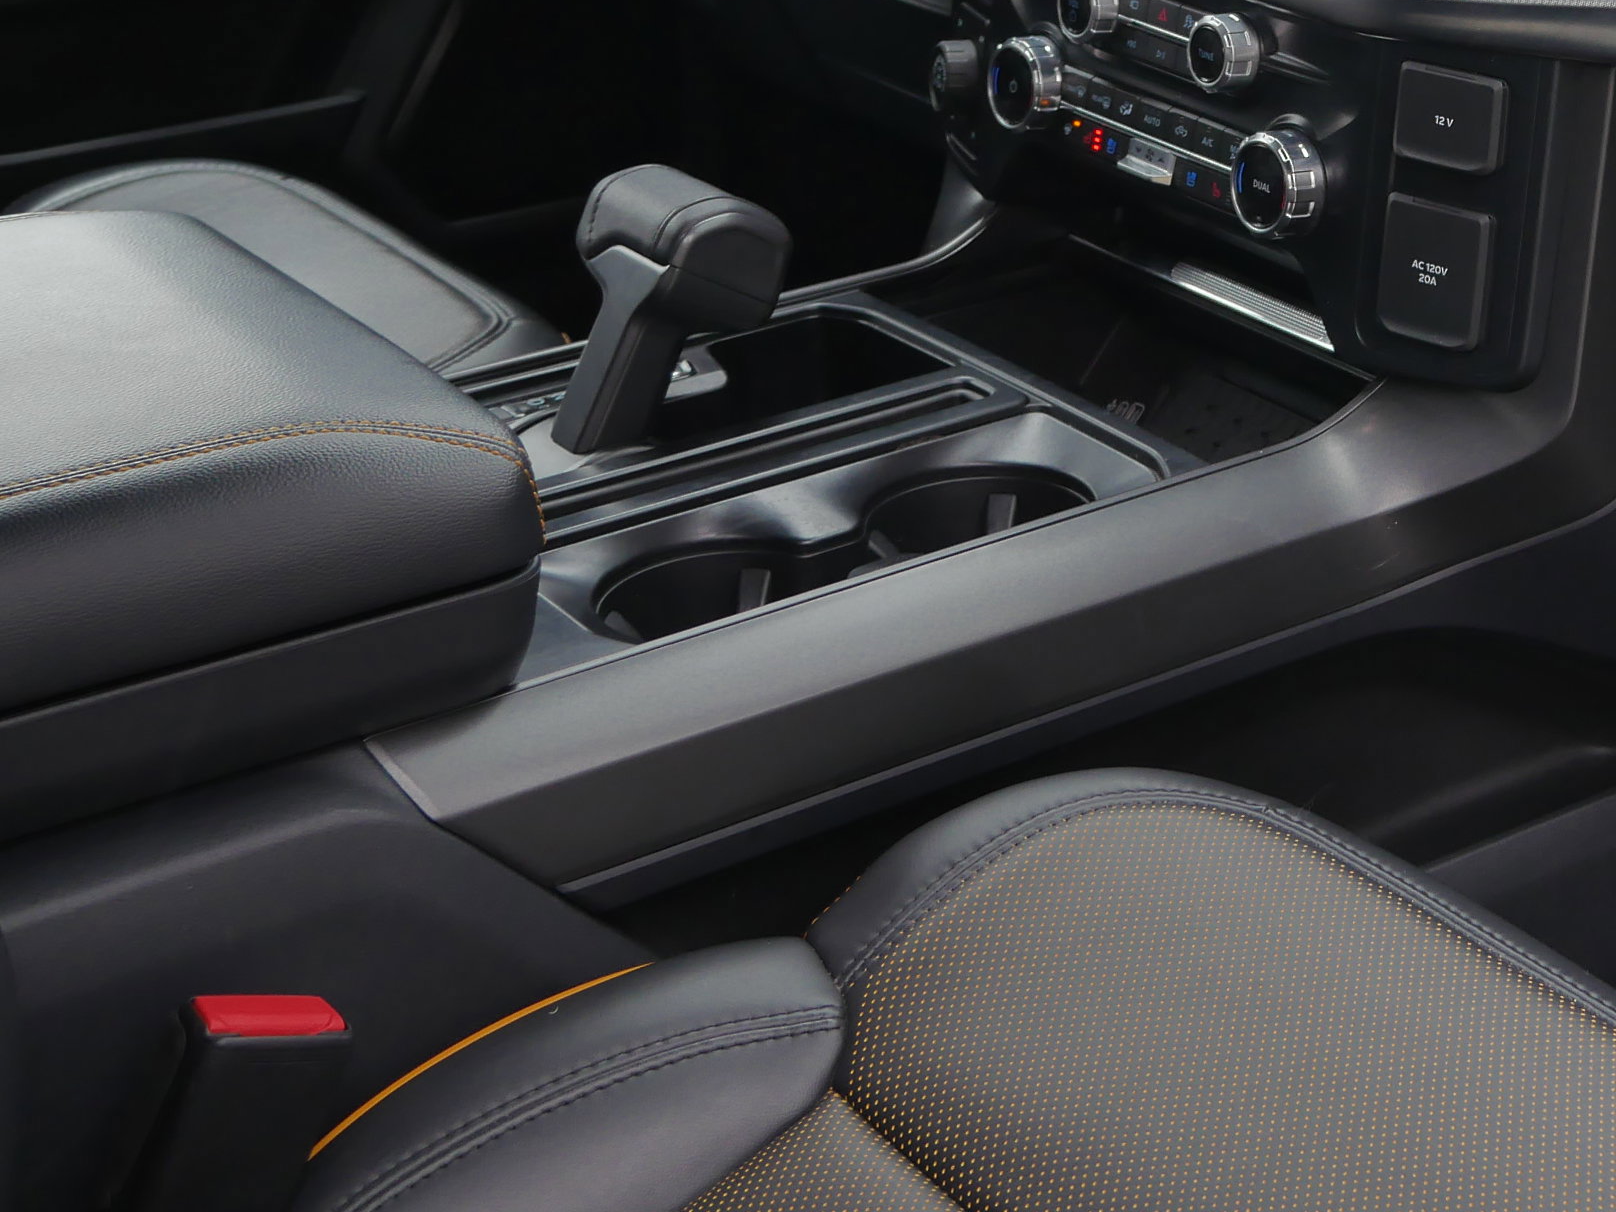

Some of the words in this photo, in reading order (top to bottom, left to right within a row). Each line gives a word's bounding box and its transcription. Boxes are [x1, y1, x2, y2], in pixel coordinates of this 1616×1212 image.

[1198, 48, 1215, 62] TUNE
[1143, 114, 1161, 128] AUTO
[1433, 114, 1446, 126] 12
[1446, 118, 1454, 128] V
[1201, 136, 1215, 148] A/C
[1252, 178, 1271, 194] DUAL
[1411, 259, 1425, 271] AC
[1425, 262, 1449, 277] 120V
[1418, 273, 1437, 287] 20A
